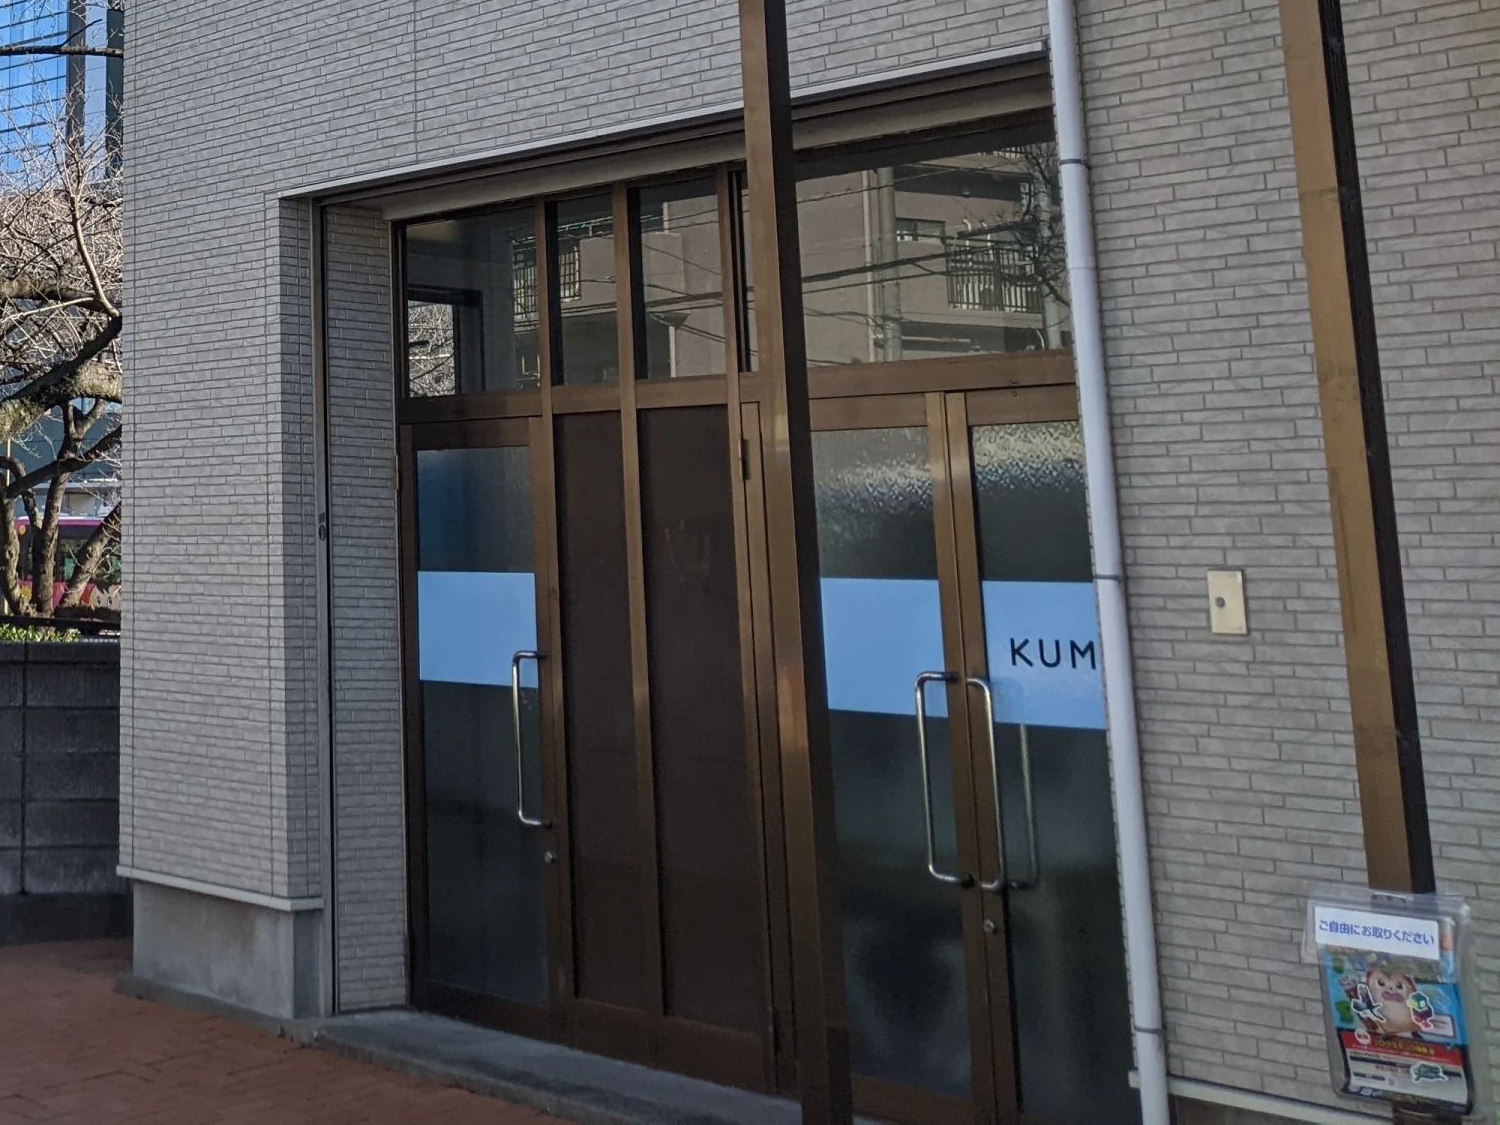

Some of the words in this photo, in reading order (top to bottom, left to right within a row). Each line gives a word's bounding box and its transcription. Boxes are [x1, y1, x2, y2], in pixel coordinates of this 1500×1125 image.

[1319, 920, 1434, 944] ご自由にお取りください
